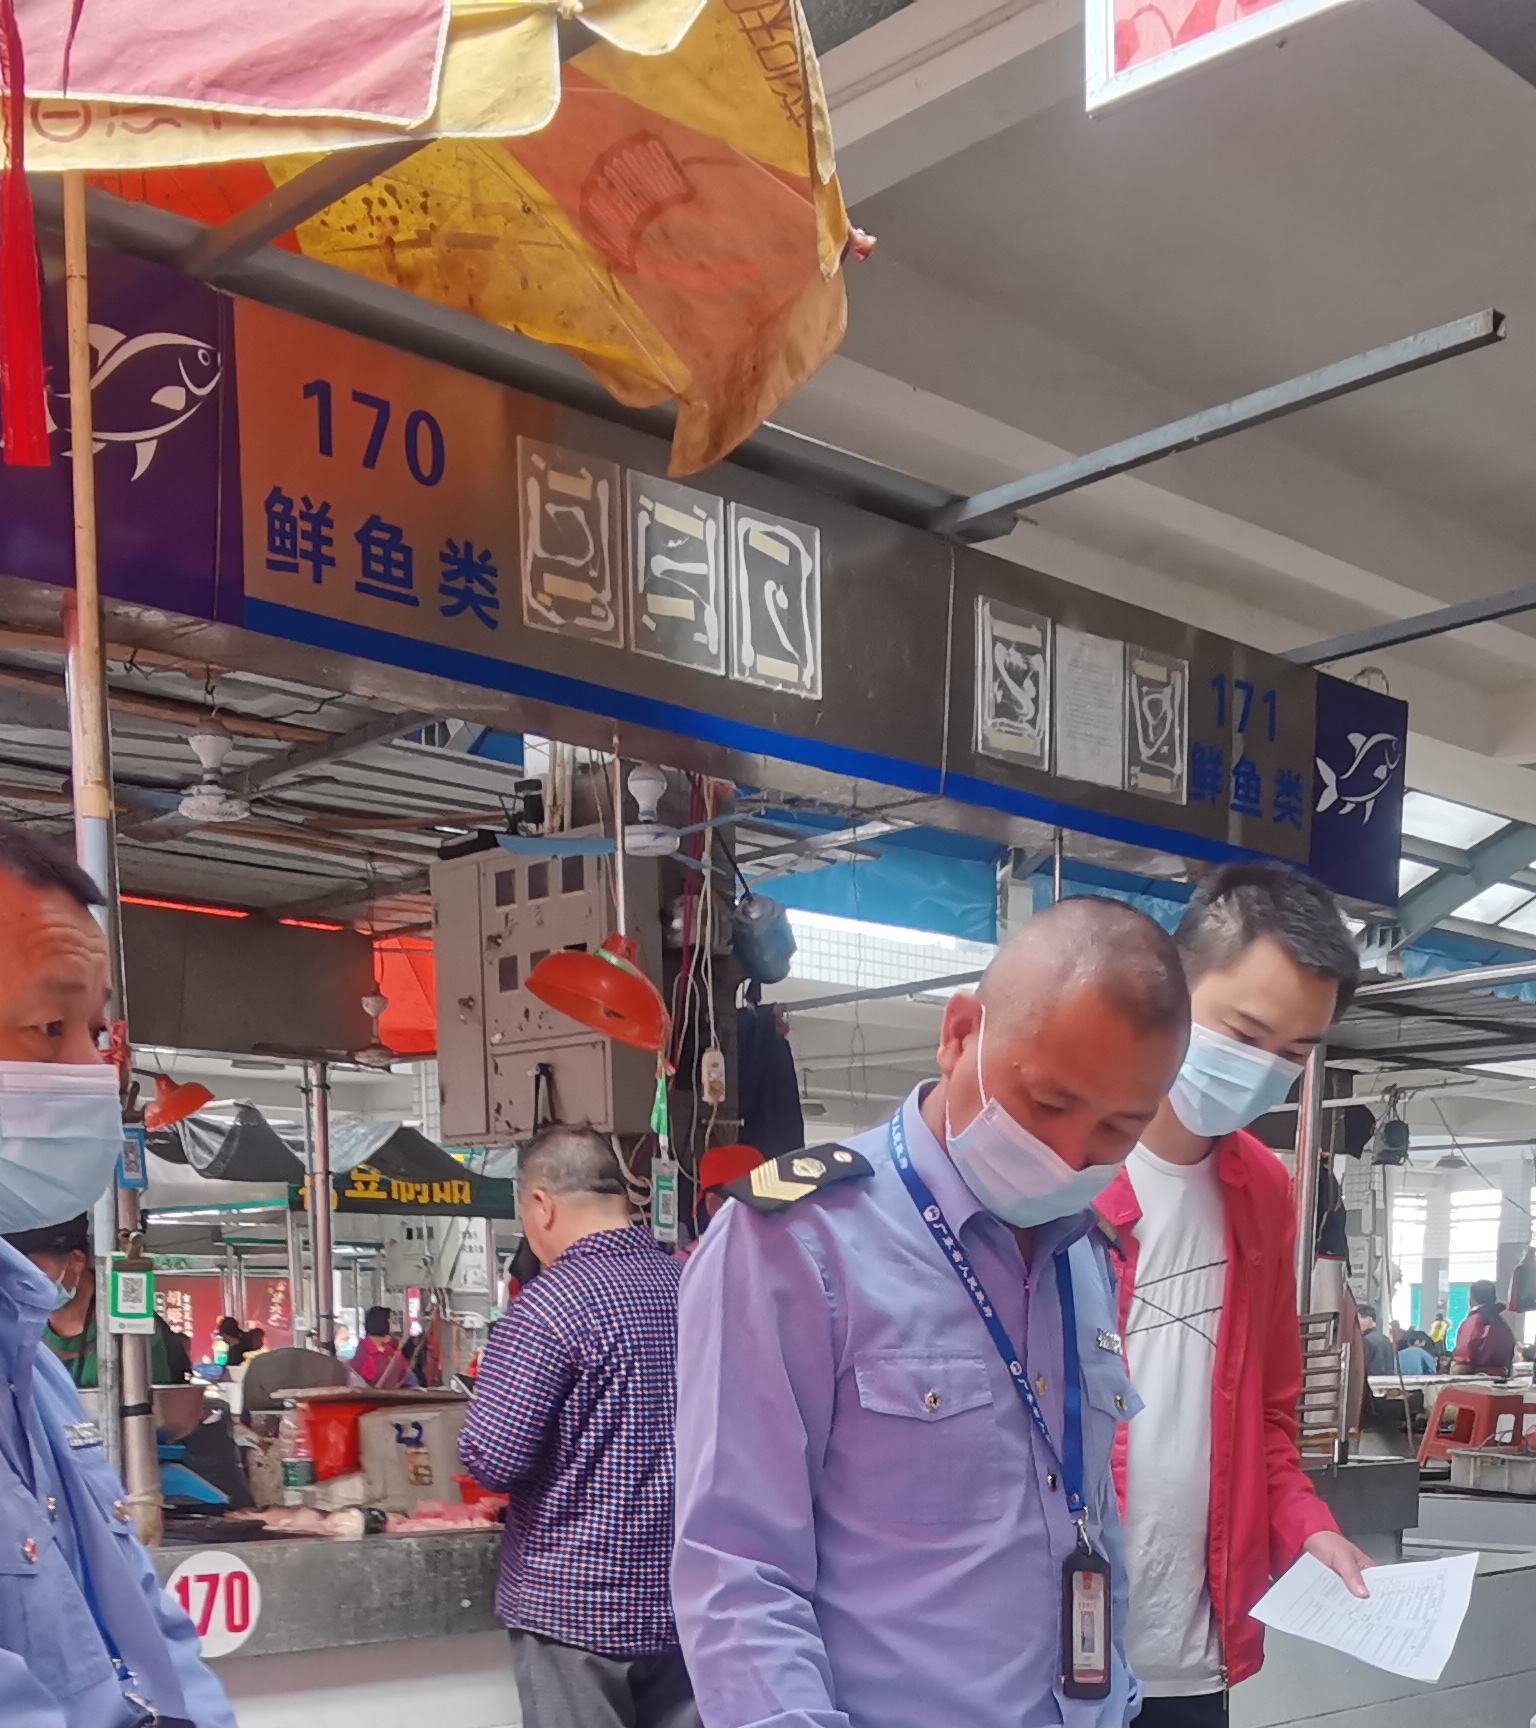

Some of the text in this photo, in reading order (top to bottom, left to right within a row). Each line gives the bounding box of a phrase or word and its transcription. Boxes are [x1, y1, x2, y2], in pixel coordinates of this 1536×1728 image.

[302, 378, 446, 487] 170
[264, 485, 500, 631] 鲜鱼类
[1210, 673, 1278, 742] 171
[1190, 742, 1304, 830] 鲜鱼类
[174, 1571, 250, 1637] 170
